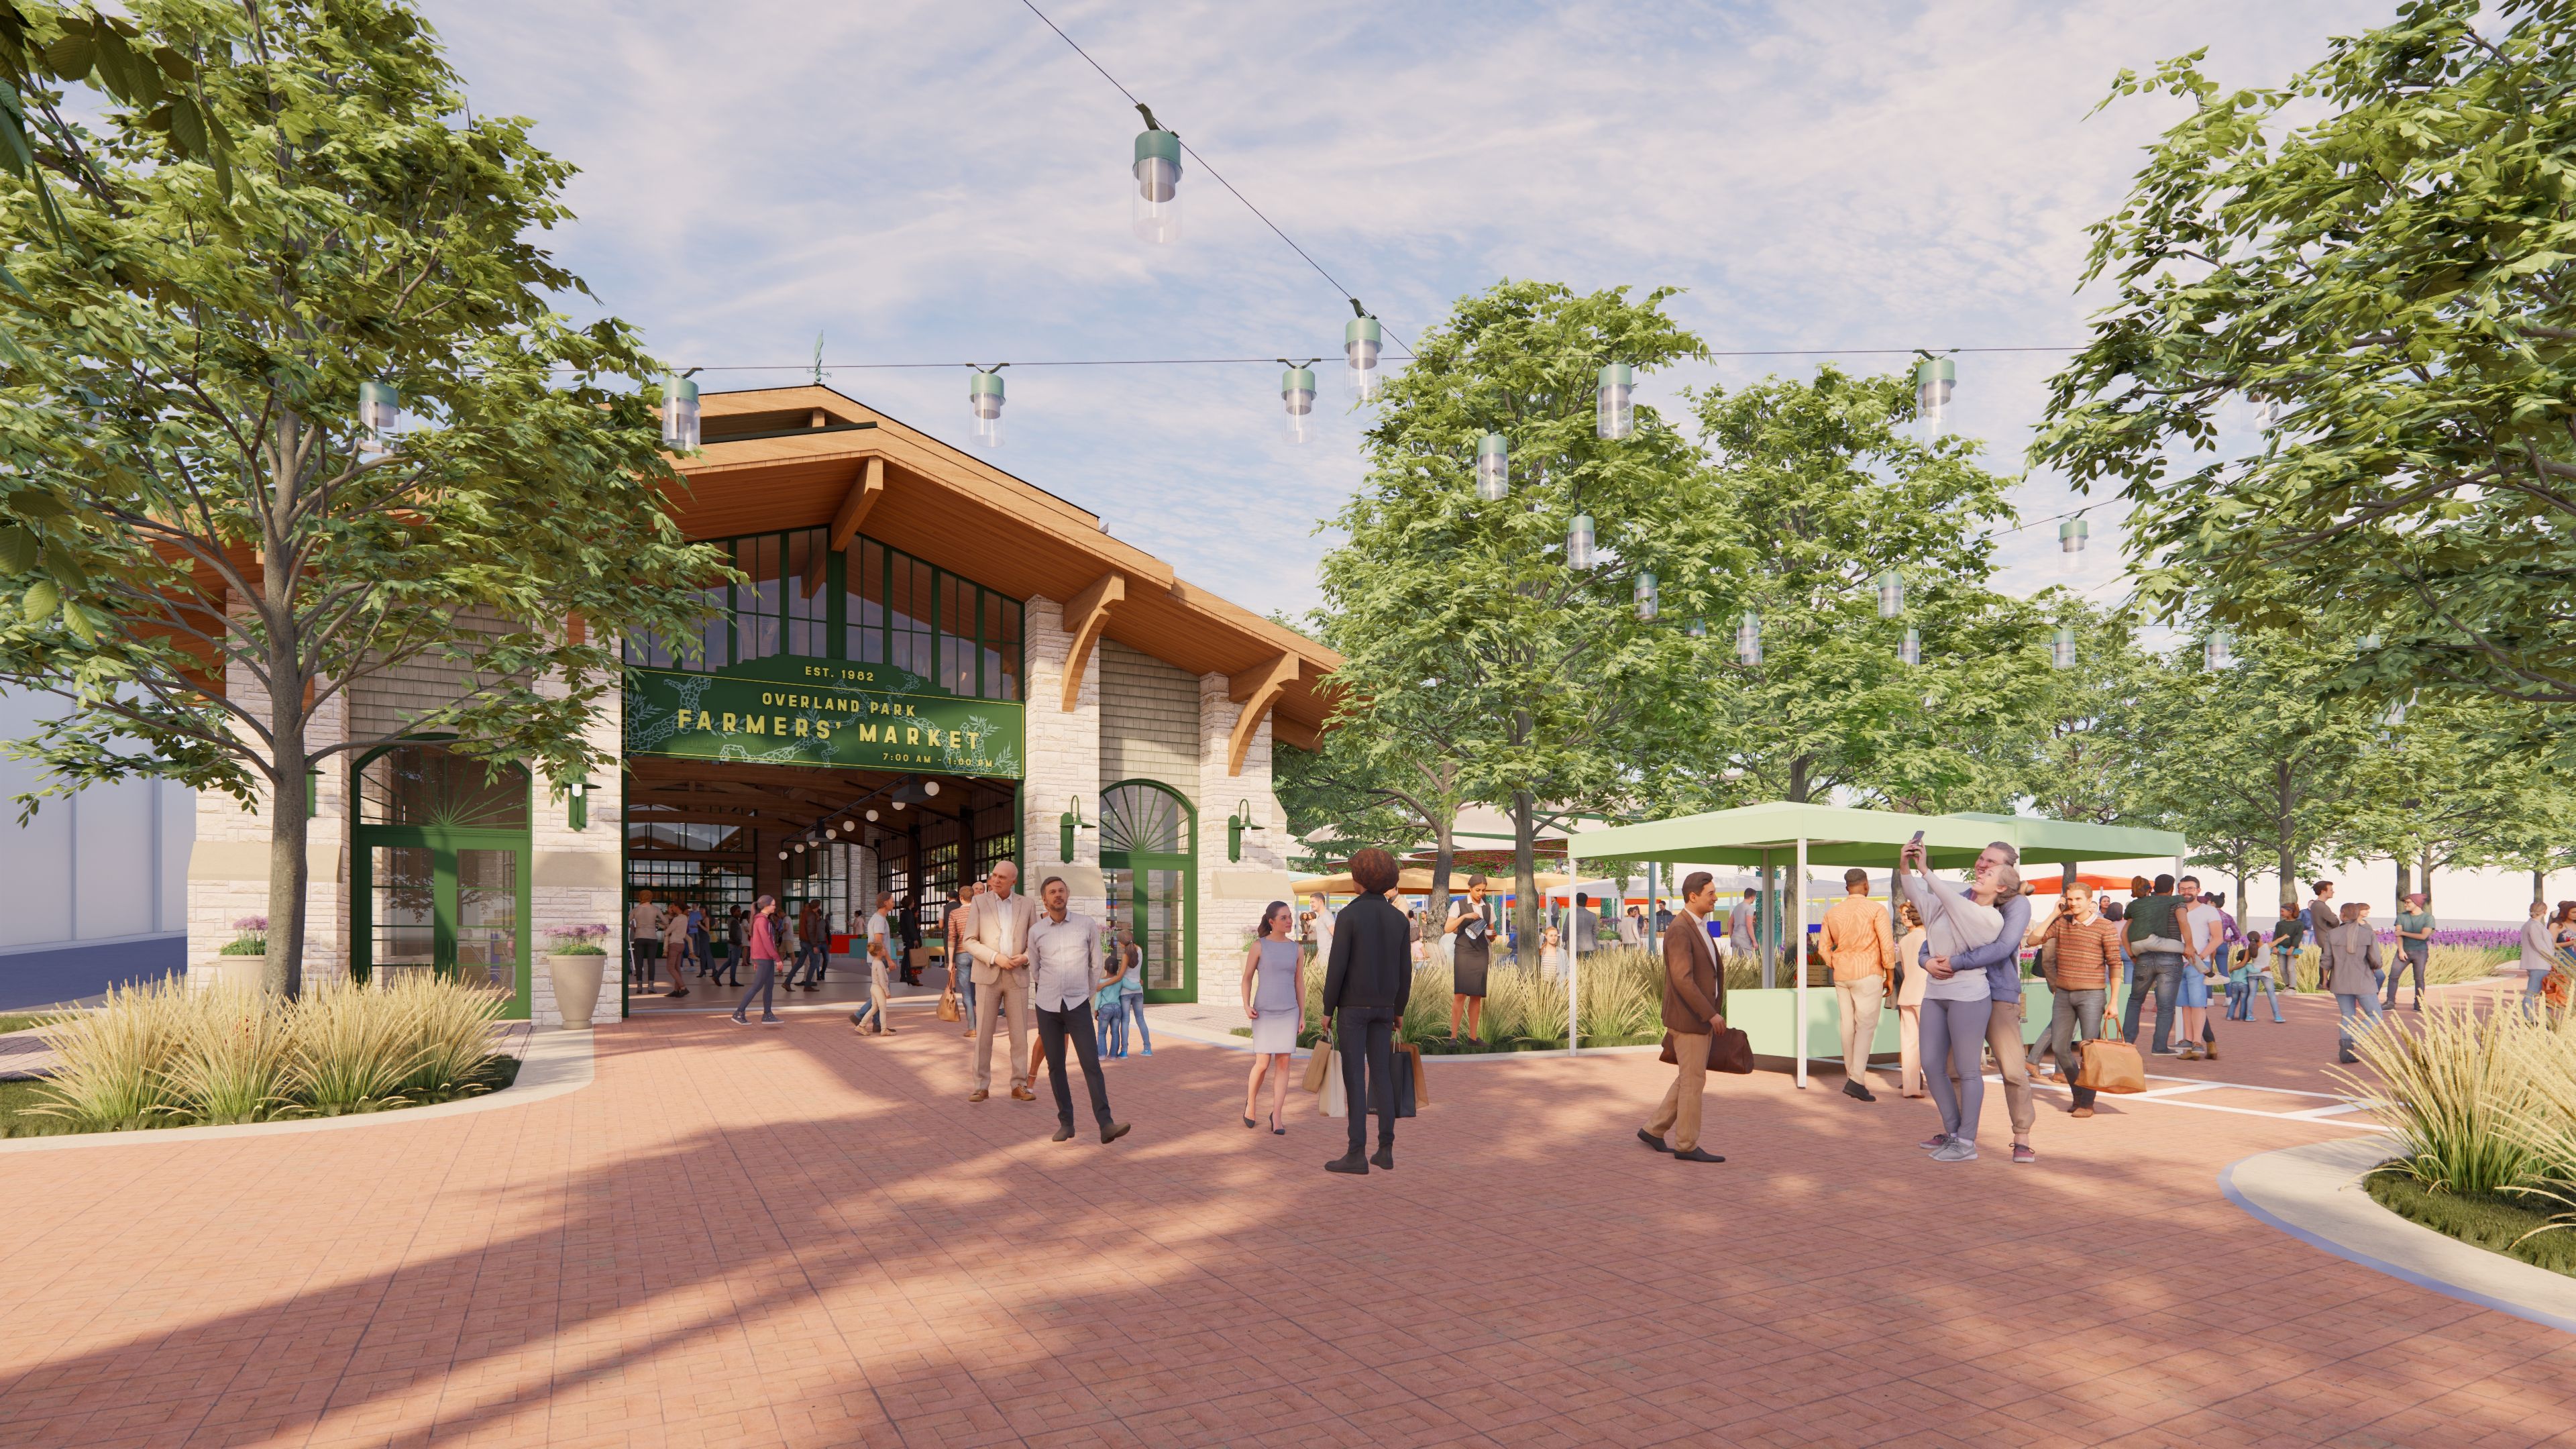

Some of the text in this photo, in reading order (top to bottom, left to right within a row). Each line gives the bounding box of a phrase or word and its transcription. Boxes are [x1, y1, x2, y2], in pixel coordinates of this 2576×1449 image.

[805, 665, 874, 682] EST. 1982
[762, 692, 915, 716] OVERLAND PARK
[859, 723, 979, 750] MARKET
[883, 753, 910, 762] 7:00
[916, 755, 932, 763] AM
[947, 758, 972, 767] 1:00
[977, 759, 993, 767] PM
